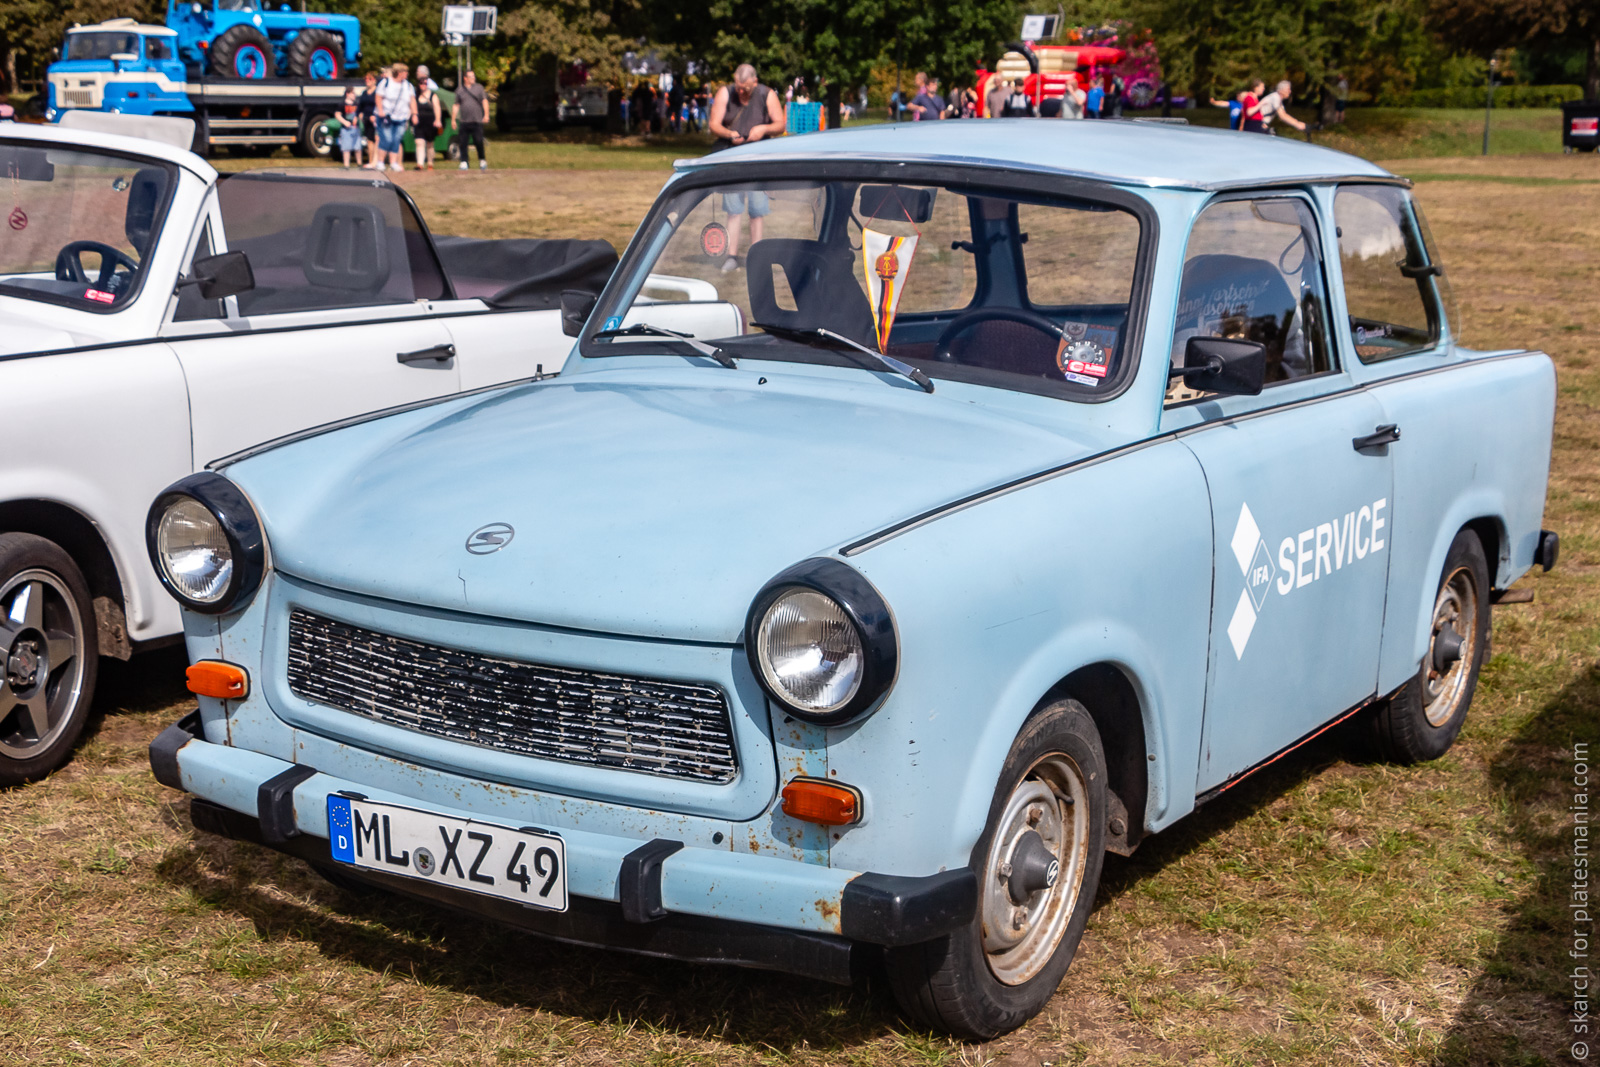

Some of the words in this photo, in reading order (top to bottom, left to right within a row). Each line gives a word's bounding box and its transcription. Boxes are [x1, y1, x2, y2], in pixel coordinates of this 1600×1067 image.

[1276, 497, 1387, 596] SERVICE
[1252, 564, 1269, 587] IFA
[338, 835, 348, 850] D
[353, 808, 410, 867] ML
[438, 825, 495, 886] XZ
[506, 841, 559, 898] 49
